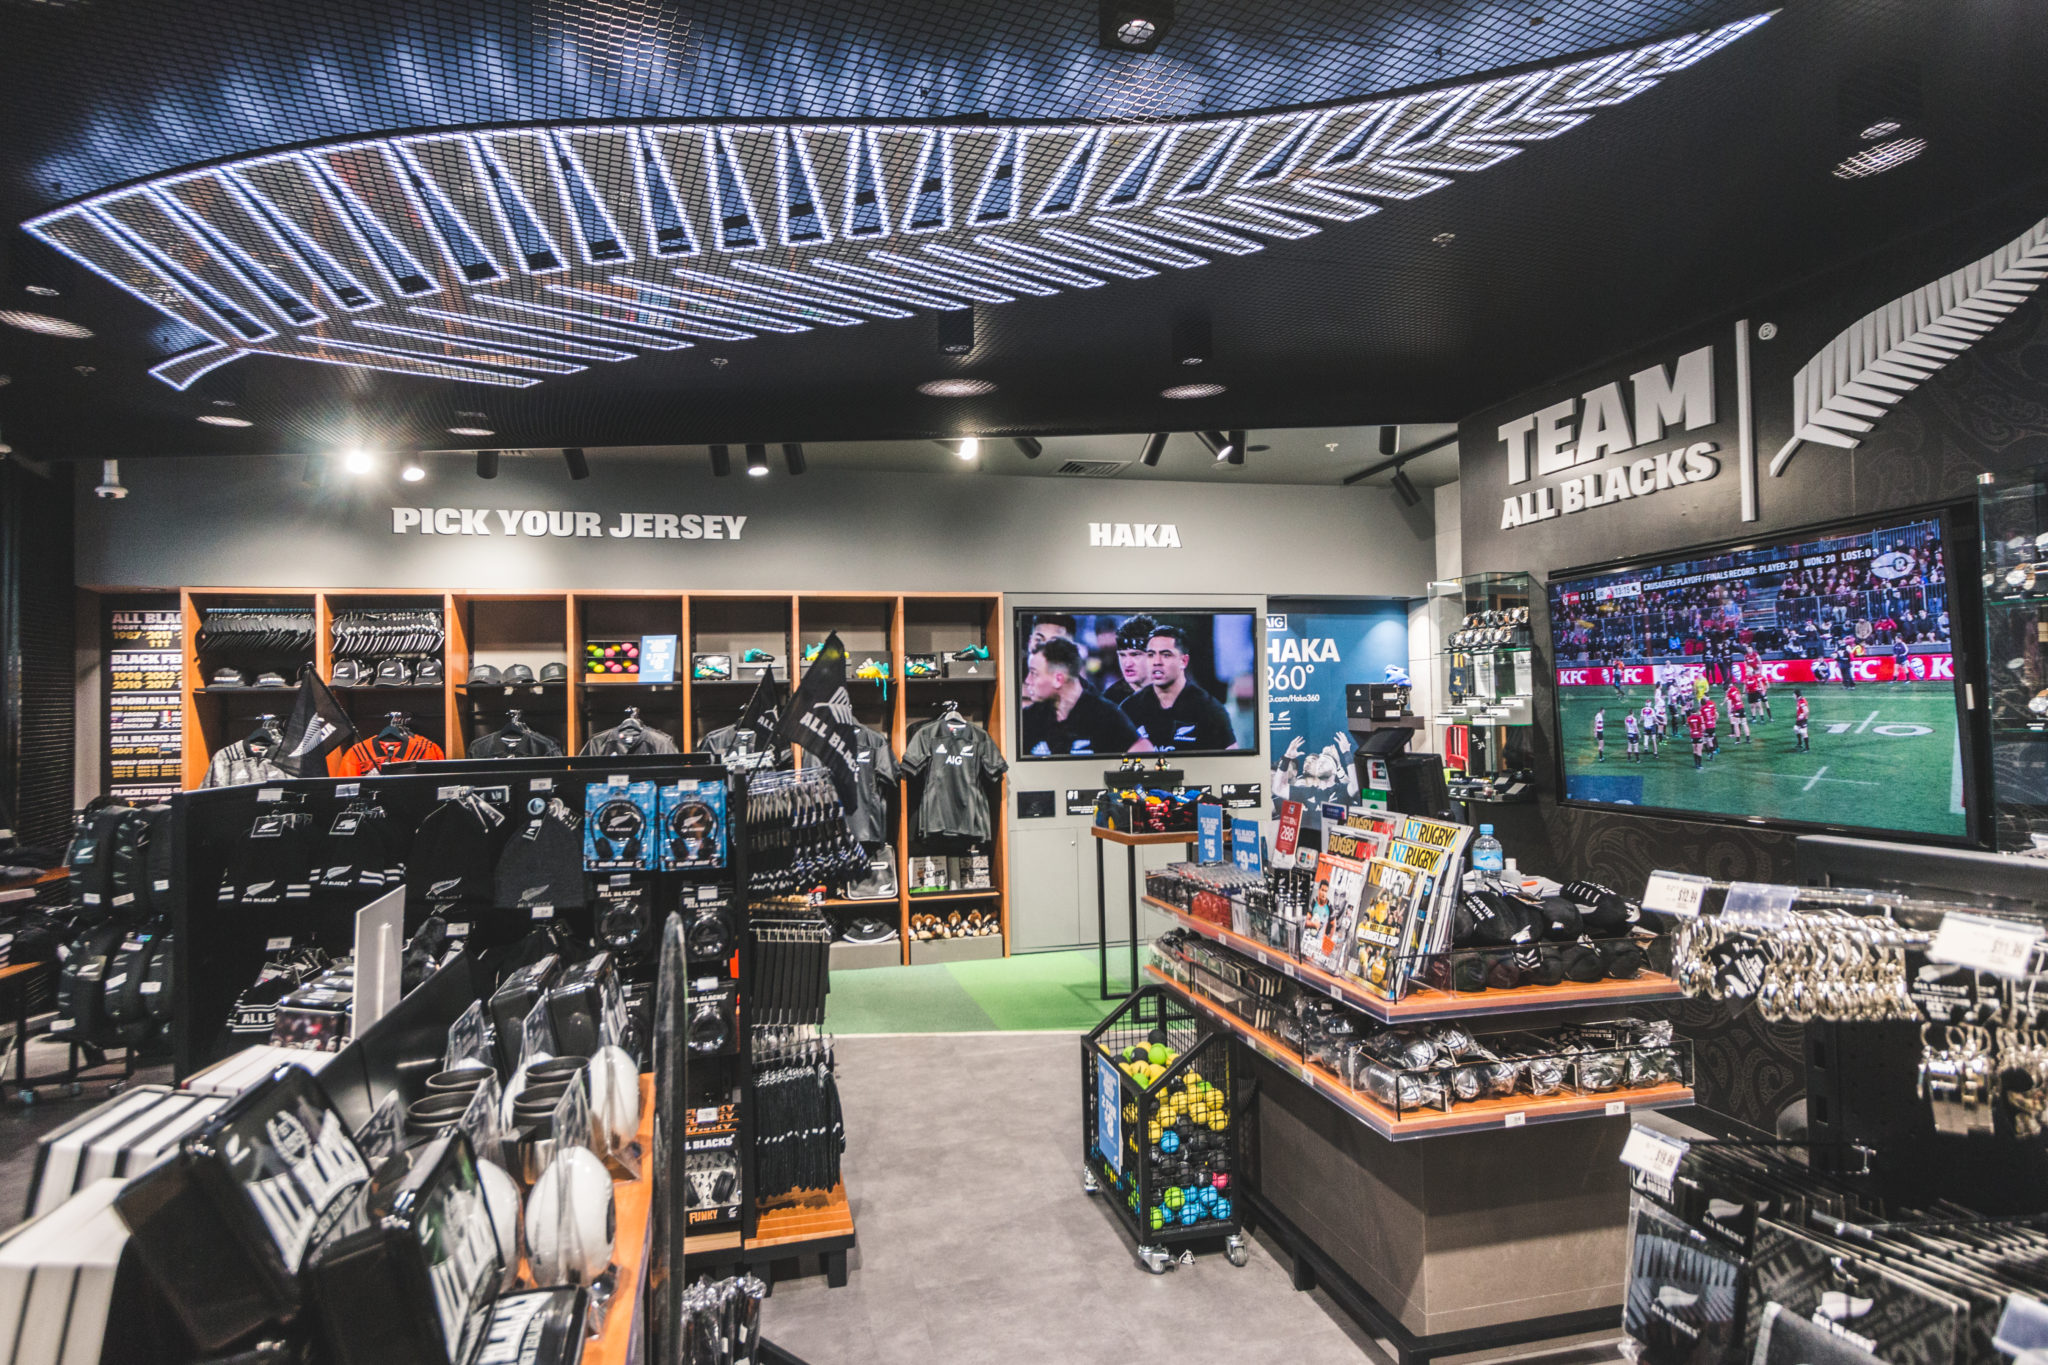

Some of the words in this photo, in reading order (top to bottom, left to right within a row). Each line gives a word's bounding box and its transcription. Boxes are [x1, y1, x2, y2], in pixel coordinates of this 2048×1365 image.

[1498, 345, 1716, 485] TEAM
[1501, 488, 1559, 530] ALL
[1560, 442, 1720, 514] BLACKS
[391, 507, 490, 535] PICK
[496, 510, 603, 537] YOUR
[609, 513, 747, 540] JERSEY
[1088, 523, 1182, 548] HAKA
[1759, 562, 1788, 574] PLAYED:
[1788, 560, 1798, 570] 20
[1804, 556, 1824, 567] WON:
[1825, 554, 1836, 564] 20
[1841, 551, 1864, 562] LOST:
[1644, 579, 1676, 590] CRUSADERS
[1677, 575, 1702, 586] PLAYOFF
[1706, 570, 1728, 581] FINALS
[1729, 566, 1757, 578] RECORD:
[112, 613, 142, 624] ALL
[111, 654, 160, 664] BLACK
[1560, 670, 1586, 684] KFC
[1761, 664, 1787, 681] FC
[112, 680, 142, 690] 2010
[148, 696, 167, 705] ALL
[757, 714, 774, 732] ALL
[800, 712, 828, 738] ALL
[111, 736, 130, 744] ALL
[130, 734, 170, 743] BLACKS
[946, 754, 963, 766] AIG
[1348, 816, 1374, 832] RUGBY
[1329, 834, 1358, 856] RUGBY
[242, 1013, 266, 1024] ALL
[692, 1137, 733, 1150] BLACKS
[245, 1172, 318, 1275] ALL
[292, 1108, 370, 1215] BLACKS
[689, 1209, 718, 1224] FUNKY
[1703, 1216, 1715, 1229] ALL
[1716, 1224, 1744, 1244] BLACKS
[1651, 1303, 1665, 1319] ALL
[1666, 1312, 1698, 1339] BLACKS
[1832, 1320, 1875, 1354] BLACKS
